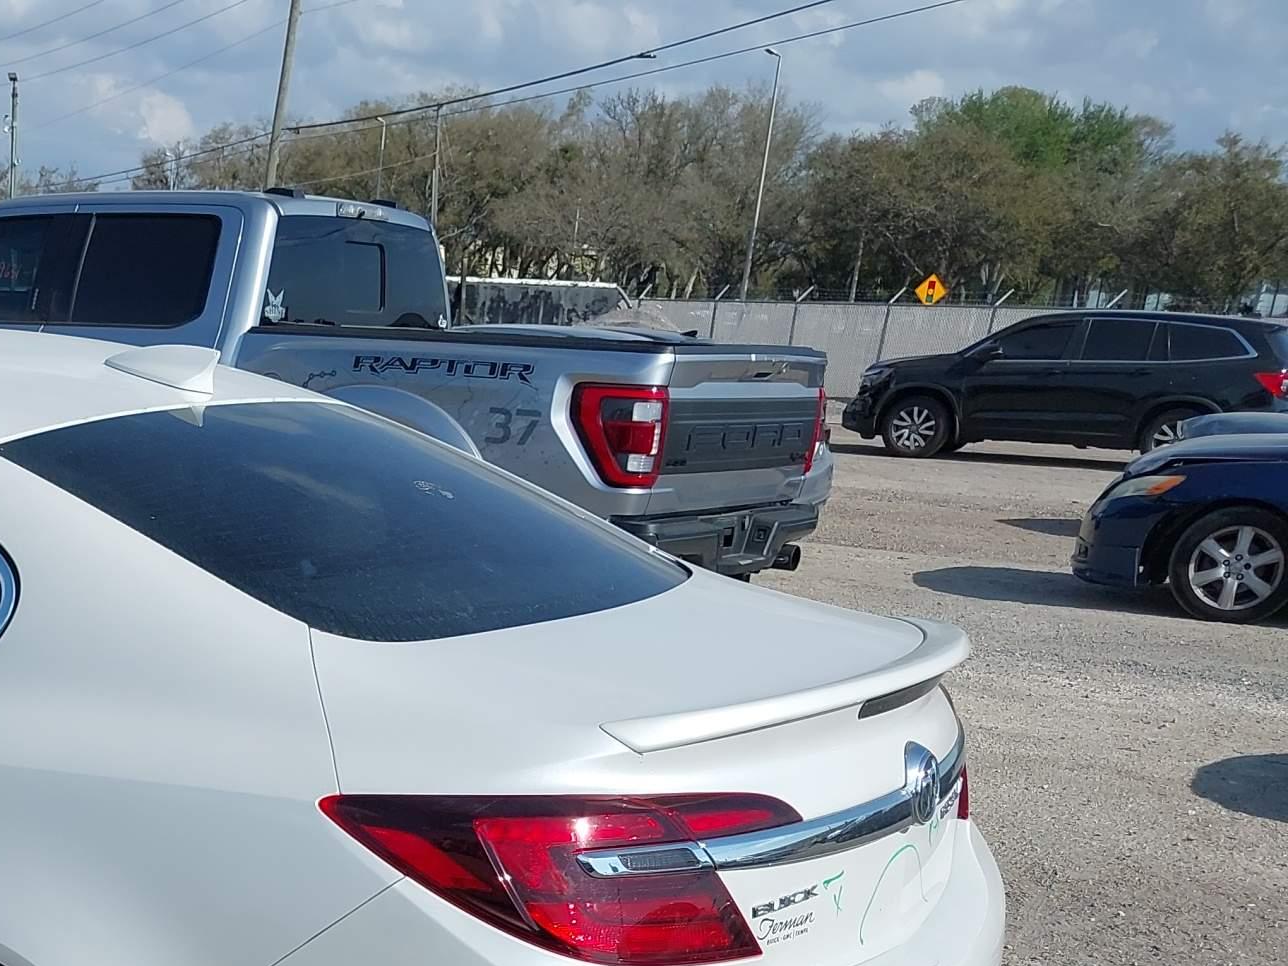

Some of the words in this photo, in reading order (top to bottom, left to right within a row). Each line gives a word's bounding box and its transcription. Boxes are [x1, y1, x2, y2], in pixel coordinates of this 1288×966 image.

[353, 355, 538, 387] RAPTOR
[485, 406, 542, 446] 37
[686, 422, 804, 451] FORD
[752, 884, 819, 919] BUICK
